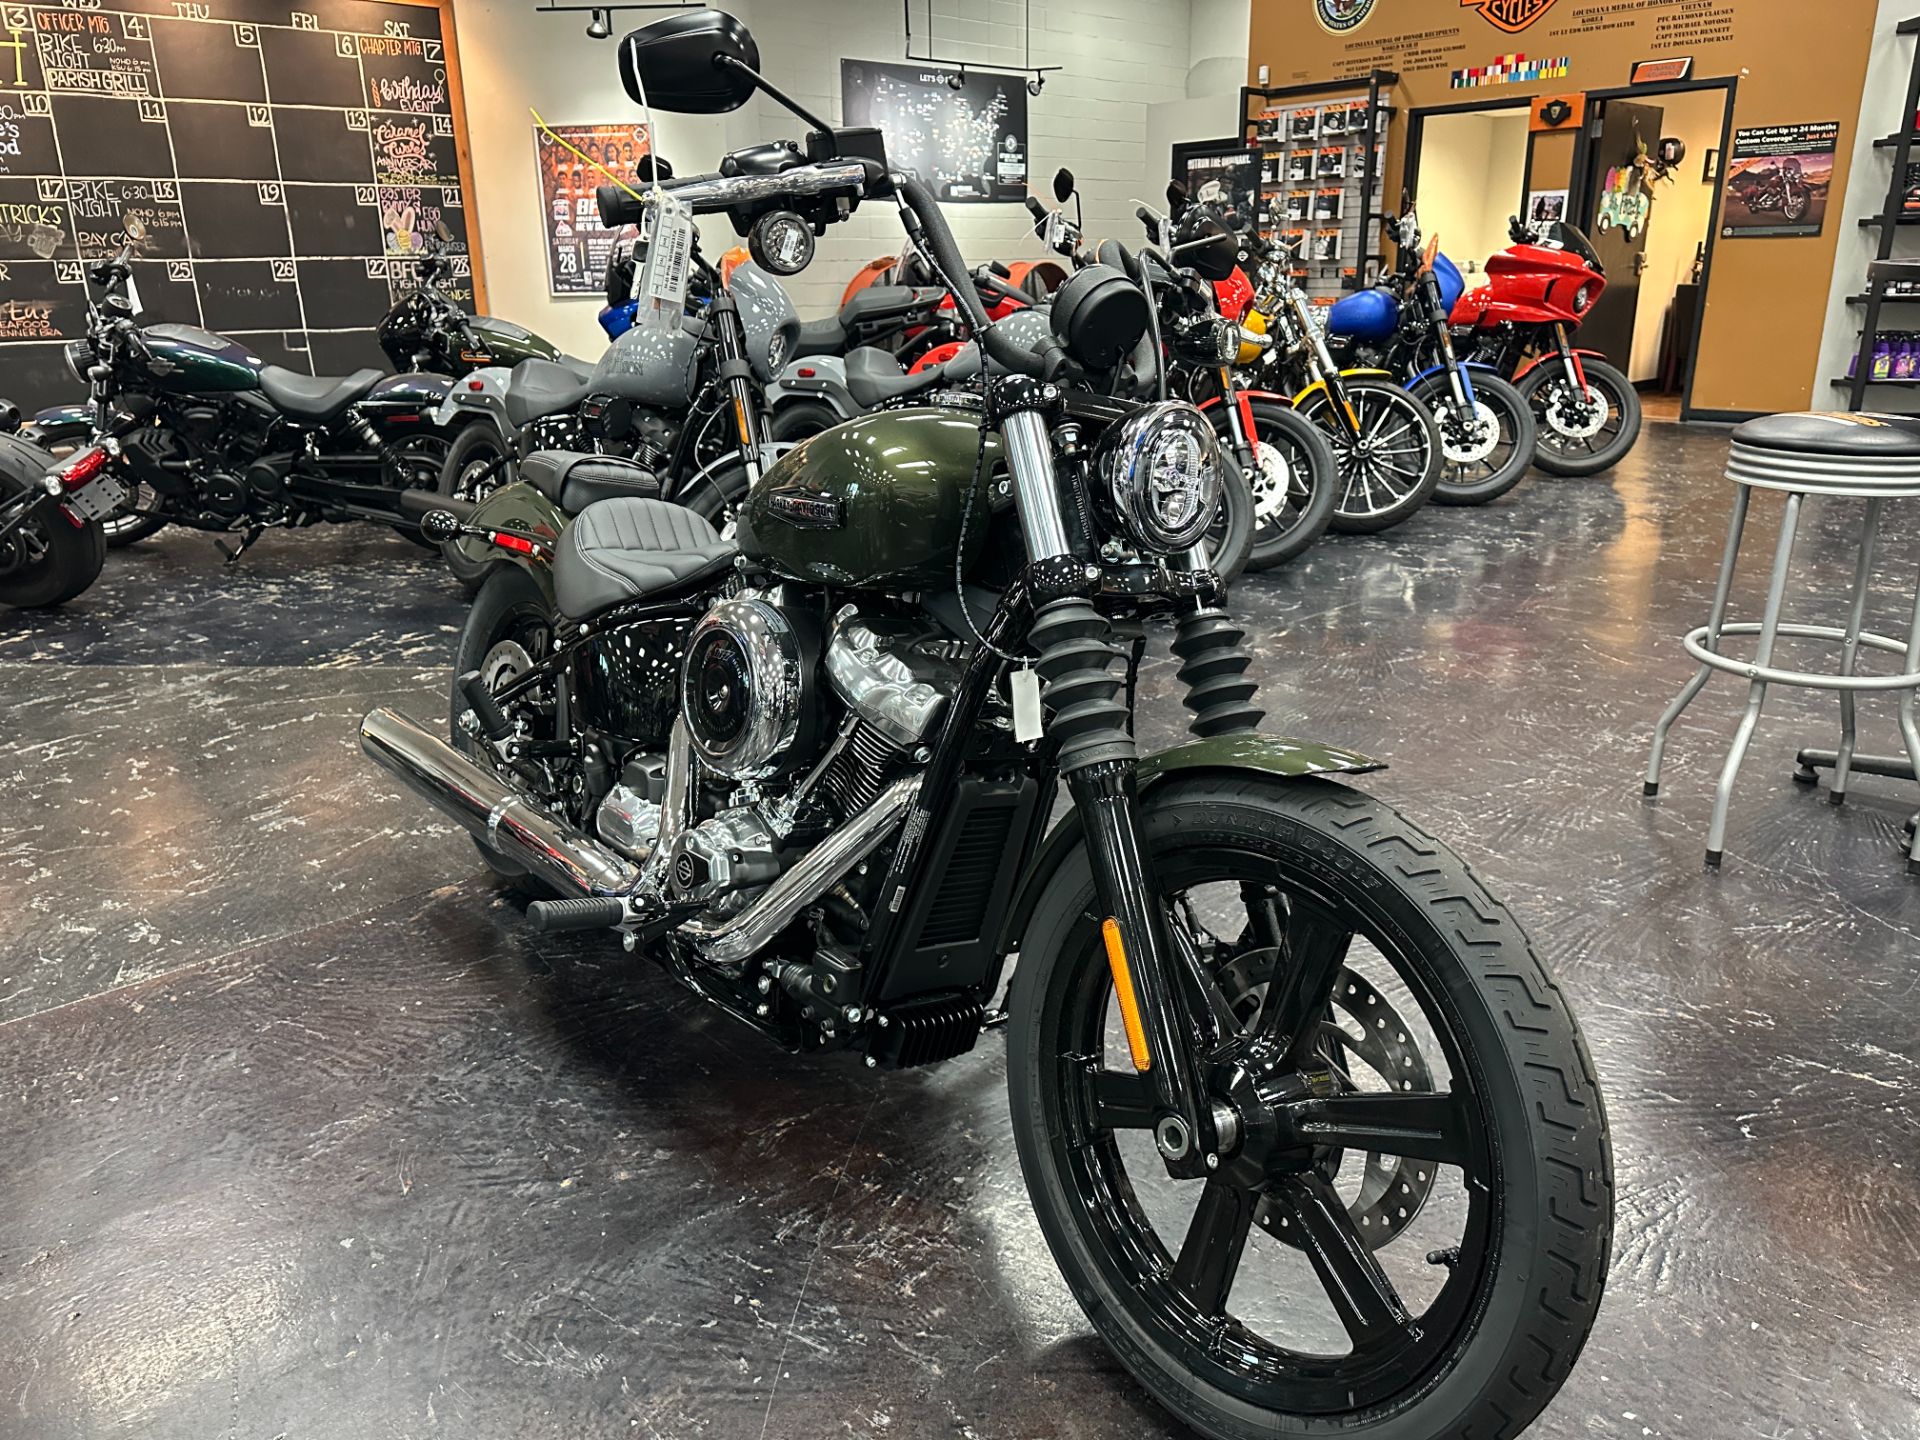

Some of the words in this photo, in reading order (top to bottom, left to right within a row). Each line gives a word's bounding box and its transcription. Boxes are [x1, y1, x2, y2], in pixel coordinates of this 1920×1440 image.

[172, 2, 210, 19] THU
[1572, 6, 1610, 17] LOUISIANA
[1611, 3, 1635, 11] MEDAL
[1681, 1, 1712, 11] VIETNAM
[8, 8, 28, 27] 3
[37, 12, 85, 31] OFFICER
[291, 12, 320, 30] FRI
[1581, 16, 1603, 24] KOREA
[1657, 15, 1671, 23] PFC
[1671, 12, 1704, 21] RAYMOND
[1673, 21, 1702, 30] MICHAEL
[127, 16, 144, 38] 4
[239, 26, 254, 43] 5
[384, 20, 410, 38] SAT
[1700, 26, 1731, 35] BENNETT
[38, 33, 82, 53] BIKE
[341, 36, 353, 54] 6
[360, 37, 401, 56] CHAPTER
[426, 43, 441, 59] 7
[1673, 38, 1702, 47] DOUGLAS
[43, 50, 91, 69] NIGHT
[50, 71, 101, 88] PARISH
[102, 73, 147, 92] GRILL
[380, 75, 442, 104] birthday
[24, 94, 49, 113] 10
[143, 101, 165, 119] 11
[400, 99, 434, 112] EVENT
[252, 107, 269, 124] 12
[348, 111, 366, 127] 13
[436, 117, 452, 133] 14
[1751, 128, 1765, 136] Can
[1779, 127, 1789, 135] Up
[1810, 123, 1837, 132] Months
[1735, 137, 1760, 145] Custom
[41, 180, 64, 198] 17
[69, 181, 118, 200] BIKE
[155, 181, 175, 198] 18
[260, 184, 280, 202] 19
[358, 187, 375, 202] 20
[445, 189, 461, 204] 21
[0, 203, 63, 225] TRICK'S
[72, 200, 121, 218] NIGHT
[422, 207, 441, 220] EGG
[416, 219, 440, 232] HUN
[78, 232, 107, 248] BAY
[58, 262, 82, 280] 24
[170, 262, 191, 279] 25
[274, 261, 294, 277] 26
[369, 260, 386, 275] 27
[453, 258, 470, 274] 28
[559, 253, 577, 273] 28
[392, 279, 424, 289] FIGHT
[436, 278, 458, 289] IGHT
